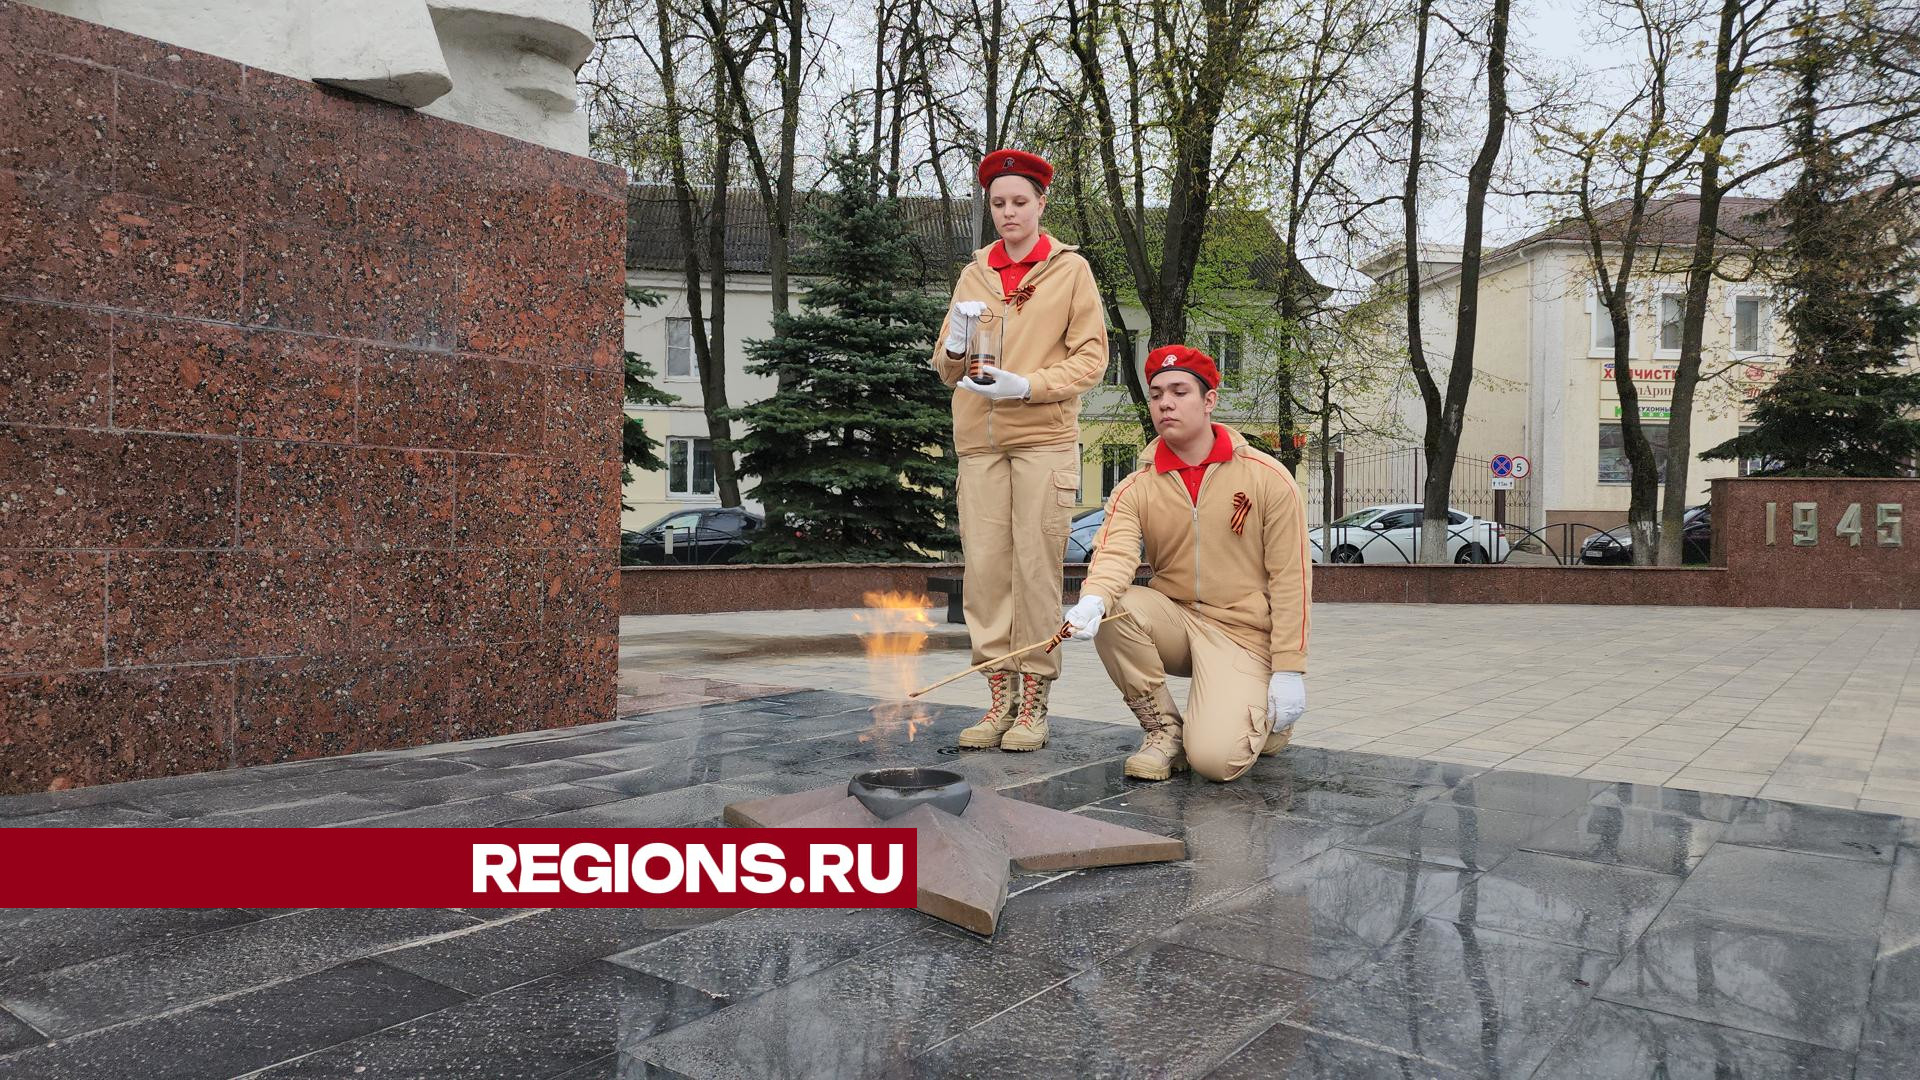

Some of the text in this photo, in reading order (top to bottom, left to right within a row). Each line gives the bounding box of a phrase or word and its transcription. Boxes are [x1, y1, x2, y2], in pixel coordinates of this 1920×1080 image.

[1603, 369, 1680, 380] ХЧИСТ
[1516, 463, 1522, 472] 5
[1765, 502, 1902, 547] 1945
